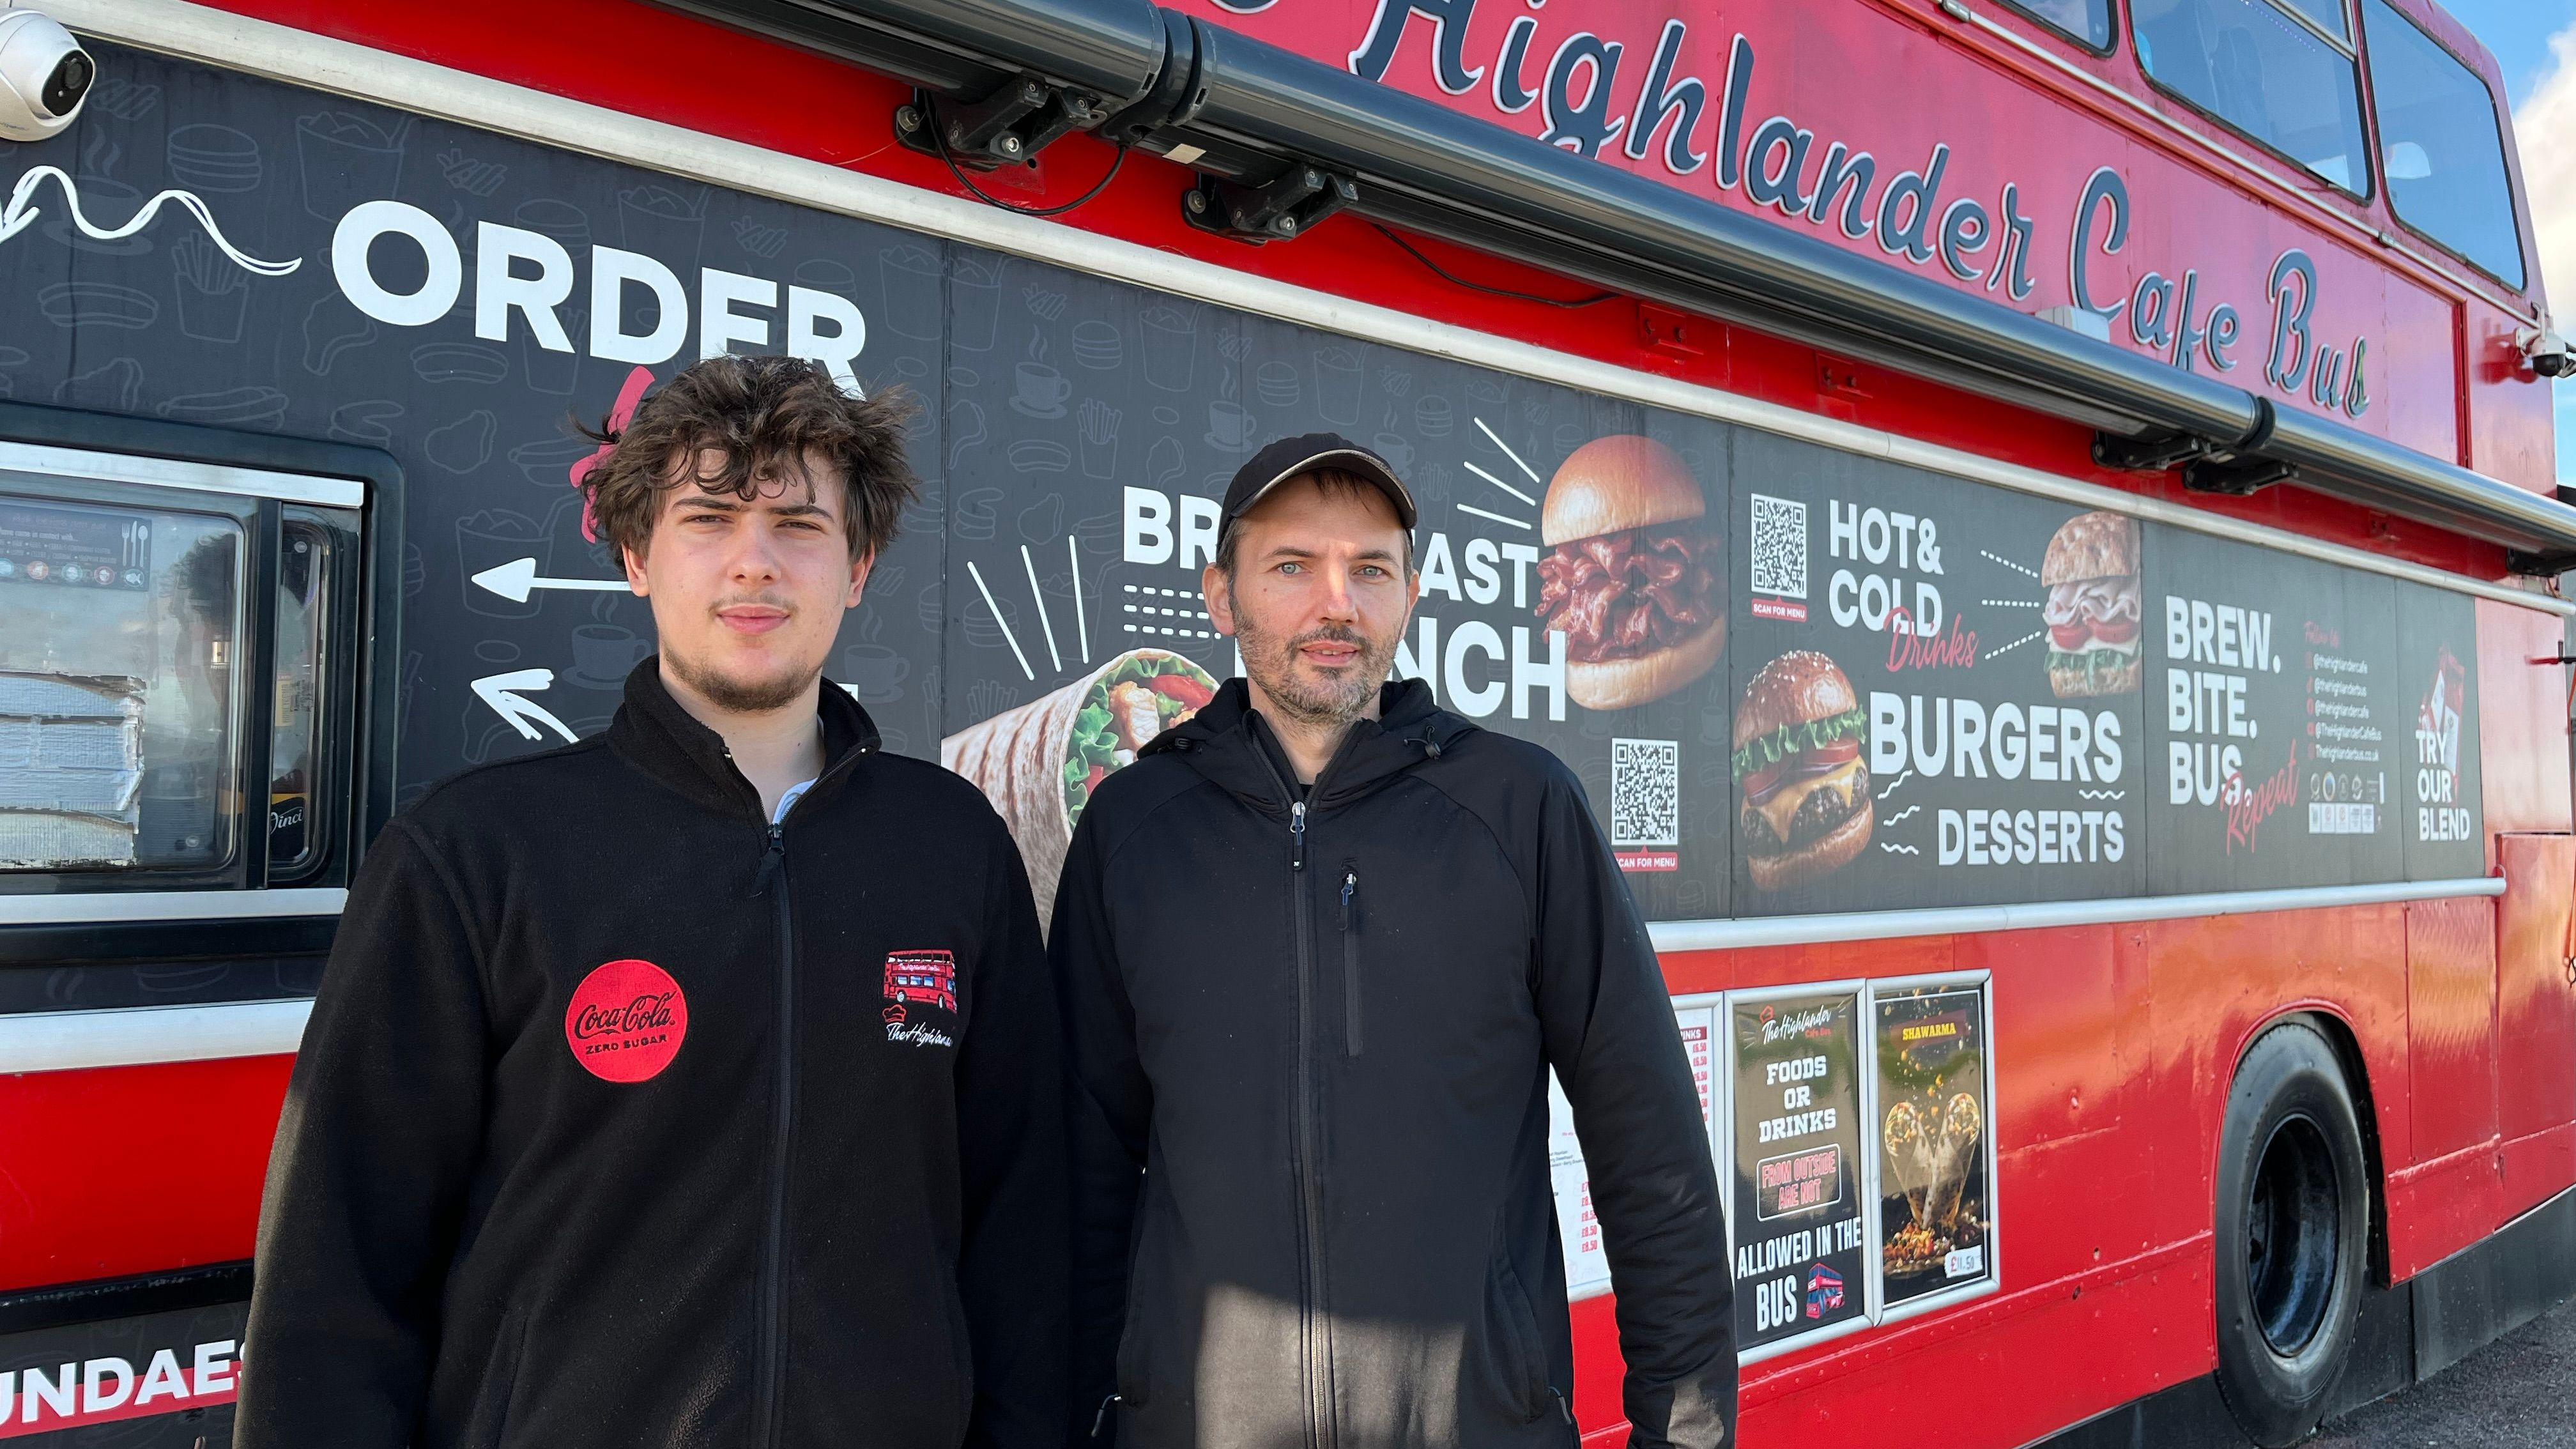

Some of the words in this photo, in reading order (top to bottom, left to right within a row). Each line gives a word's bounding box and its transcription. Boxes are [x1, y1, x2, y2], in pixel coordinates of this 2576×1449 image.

[1347, 0, 2035, 301] Highlander
[2069, 165, 2241, 371] Cafe
[2268, 248, 2370, 418] Bus
[330, 200, 868, 401] ORDER
[1123, 486, 1538, 609] BRAST
[1829, 499, 1944, 576] HOT&
[1753, 603, 1772, 614] SCAN
[1773, 606, 1786, 616] FOR
[1786, 608, 1805, 618] MENU
[1828, 569, 1943, 638] COLD
[1883, 606, 1979, 673] Drinks
[2166, 594, 2281, 673] BREW.
[1234, 617, 1566, 721] NCH
[2167, 668, 2258, 739] BITE.
[1869, 691, 2122, 783] BURGERS
[2416, 730, 2447, 765] TRY
[2219, 738, 2300, 856] Repeat
[2417, 768, 2451, 803] OUR
[1938, 808, 2124, 866] DESSERTS
[2419, 807, 2471, 842] BLEND
[1637, 857, 1652, 868] FOR
[1653, 857, 1676, 867] MENU
[574, 990, 677, 1039] Coca-Cola
[886, 1022, 906, 1041] The
[1681, 1028, 1701, 1041] INKS
[1761, 1019, 1779, 1045] The
[1778, 1004, 1832, 1041] Highlander
[1902, 1022, 1957, 1041] SHAWARMA
[585, 1042, 619, 1055] ZERO
[623, 1034, 667, 1049] SUGAR
[1766, 1055, 1827, 1085] FOODS
[1784, 1085, 1811, 1110] OR
[1758, 1107, 1837, 1144] DRINKS
[1762, 1160, 1792, 1189] FROM
[1793, 1150, 1836, 1182] OUTSIDE
[1777, 1183, 1799, 1211] ARE
[1800, 1178, 1821, 1205] NOT
[1581, 1224, 1597, 1238] £8.50
[1581, 1239, 1598, 1253] £8.50
[1736, 1230, 1812, 1280] ALLOWED
[1816, 1224, 1832, 1258] IN
[1834, 1216, 1862, 1252] THE
[1756, 1275, 1797, 1332] BUS
[0, 1339, 247, 1427] NDAE
